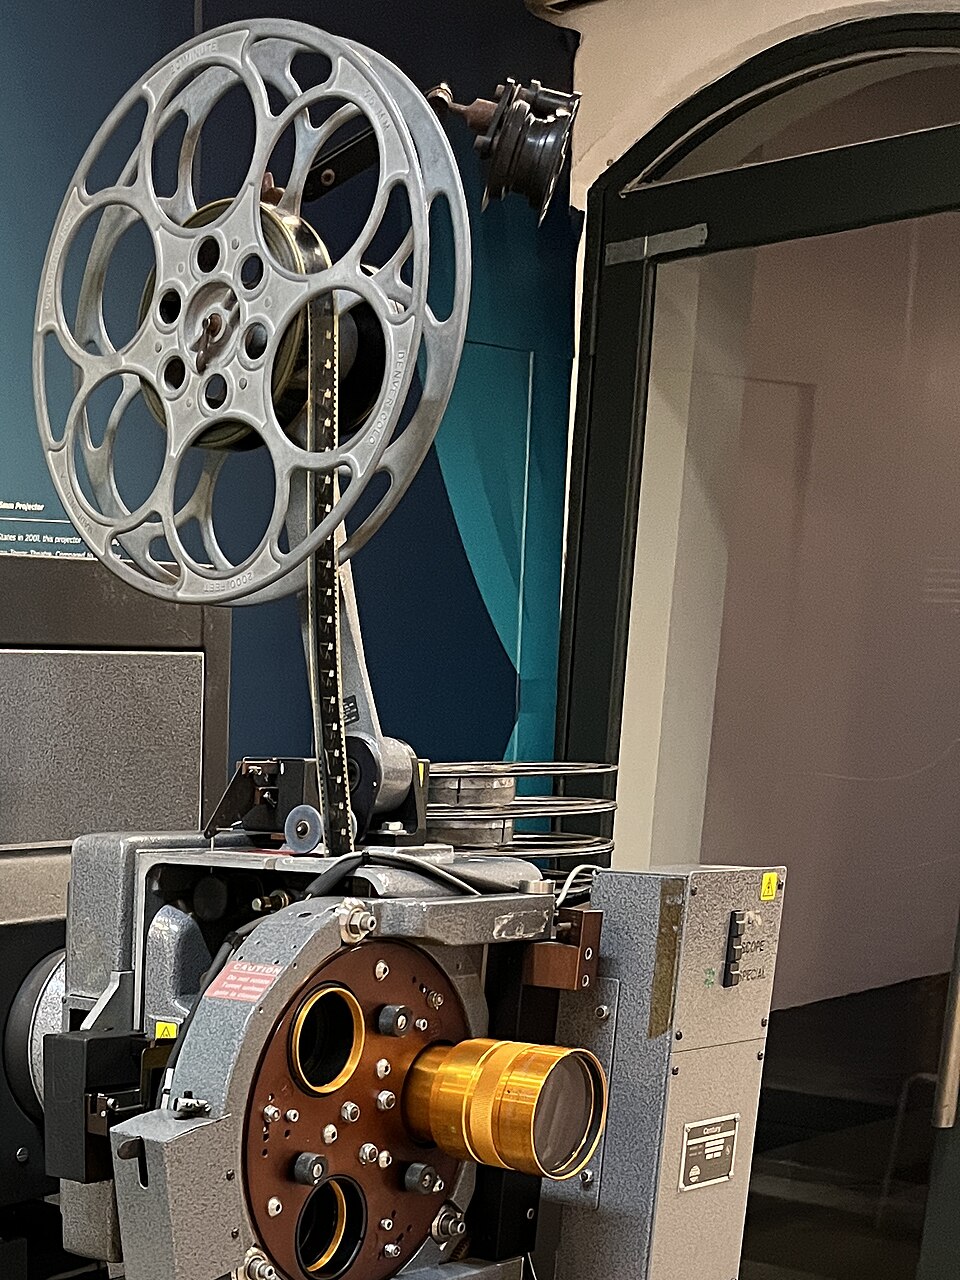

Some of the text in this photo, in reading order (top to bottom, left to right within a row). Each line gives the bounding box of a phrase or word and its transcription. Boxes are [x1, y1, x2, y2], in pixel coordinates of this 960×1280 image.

[369, 351, 406, 445] DENVER COLO
[15, 501, 45, 512] Projector
[17, 533, 24, 541] in
[42, 534, 54, 543] this
[54, 536, 82, 545] projector
[230, 572, 253, 589] 2000
[233, 963, 283, 975] CAUTION
